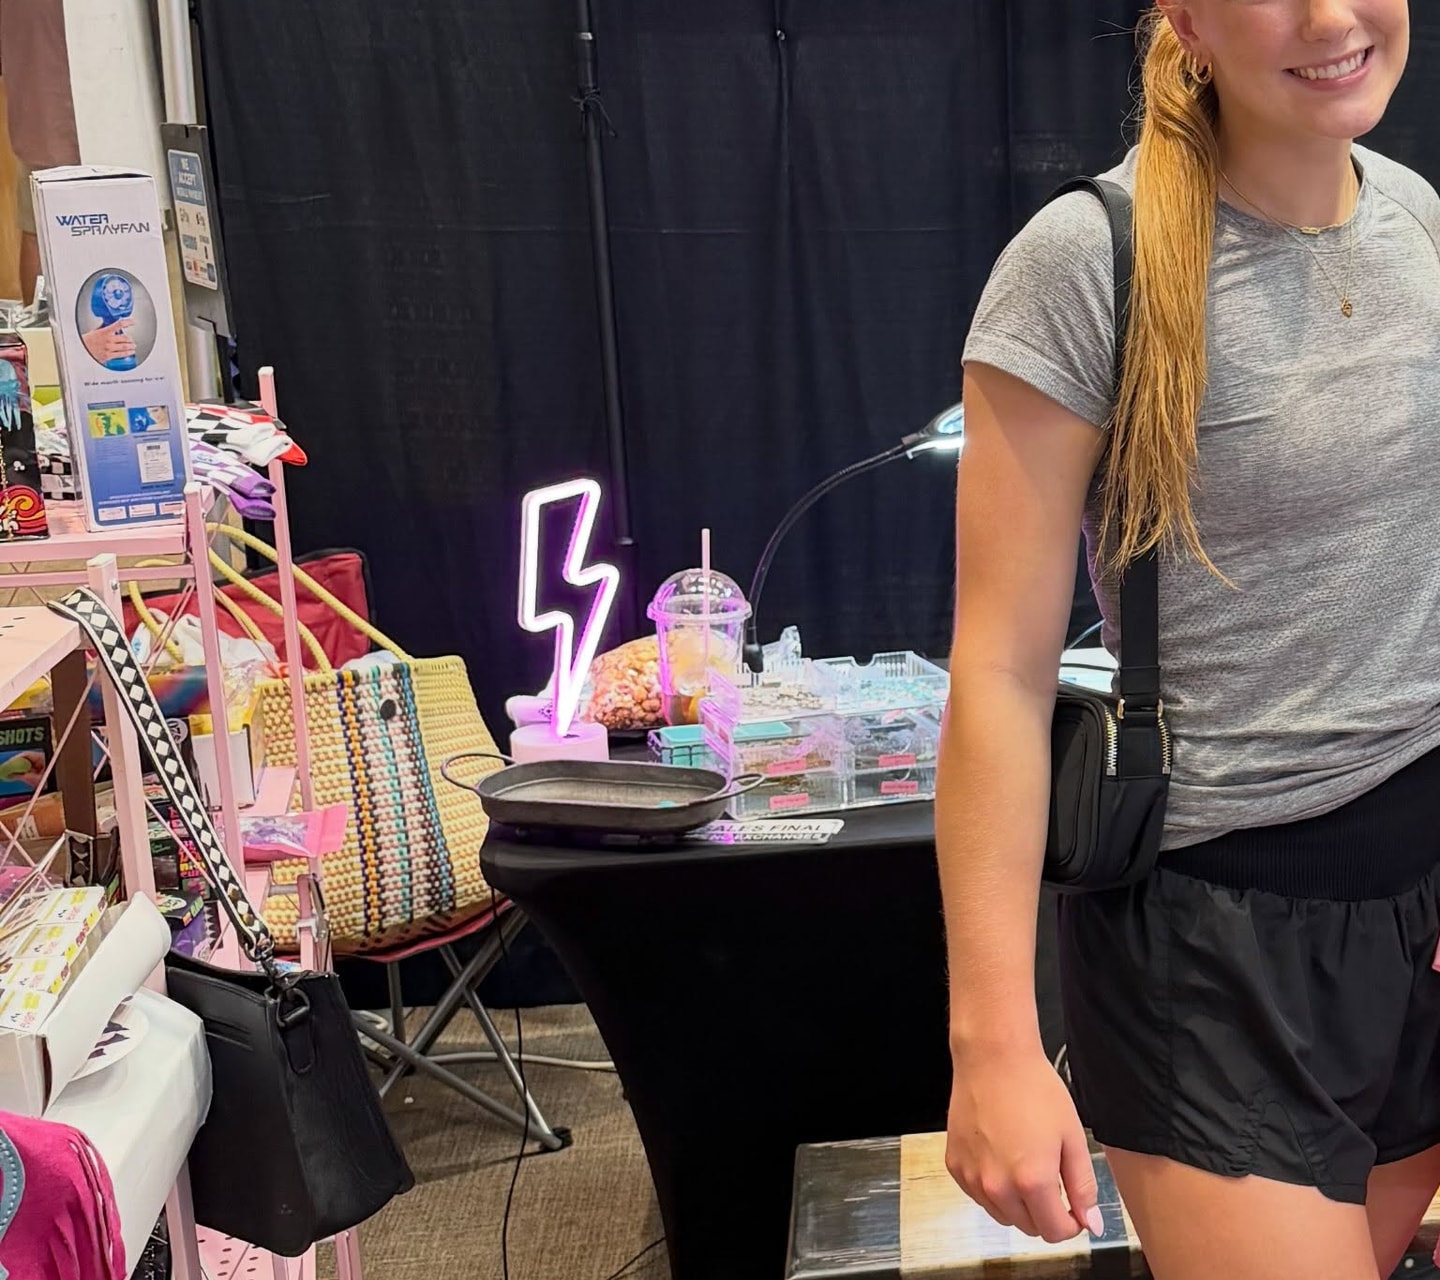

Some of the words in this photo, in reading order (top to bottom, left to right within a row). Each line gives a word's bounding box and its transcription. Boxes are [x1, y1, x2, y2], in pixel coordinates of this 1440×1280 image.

[56, 213, 109, 226] WATER
[71, 222, 150, 236] SPRAYFAN
[0, 726, 45, 746] SHOTS
[769, 824, 822, 832] FINAL
